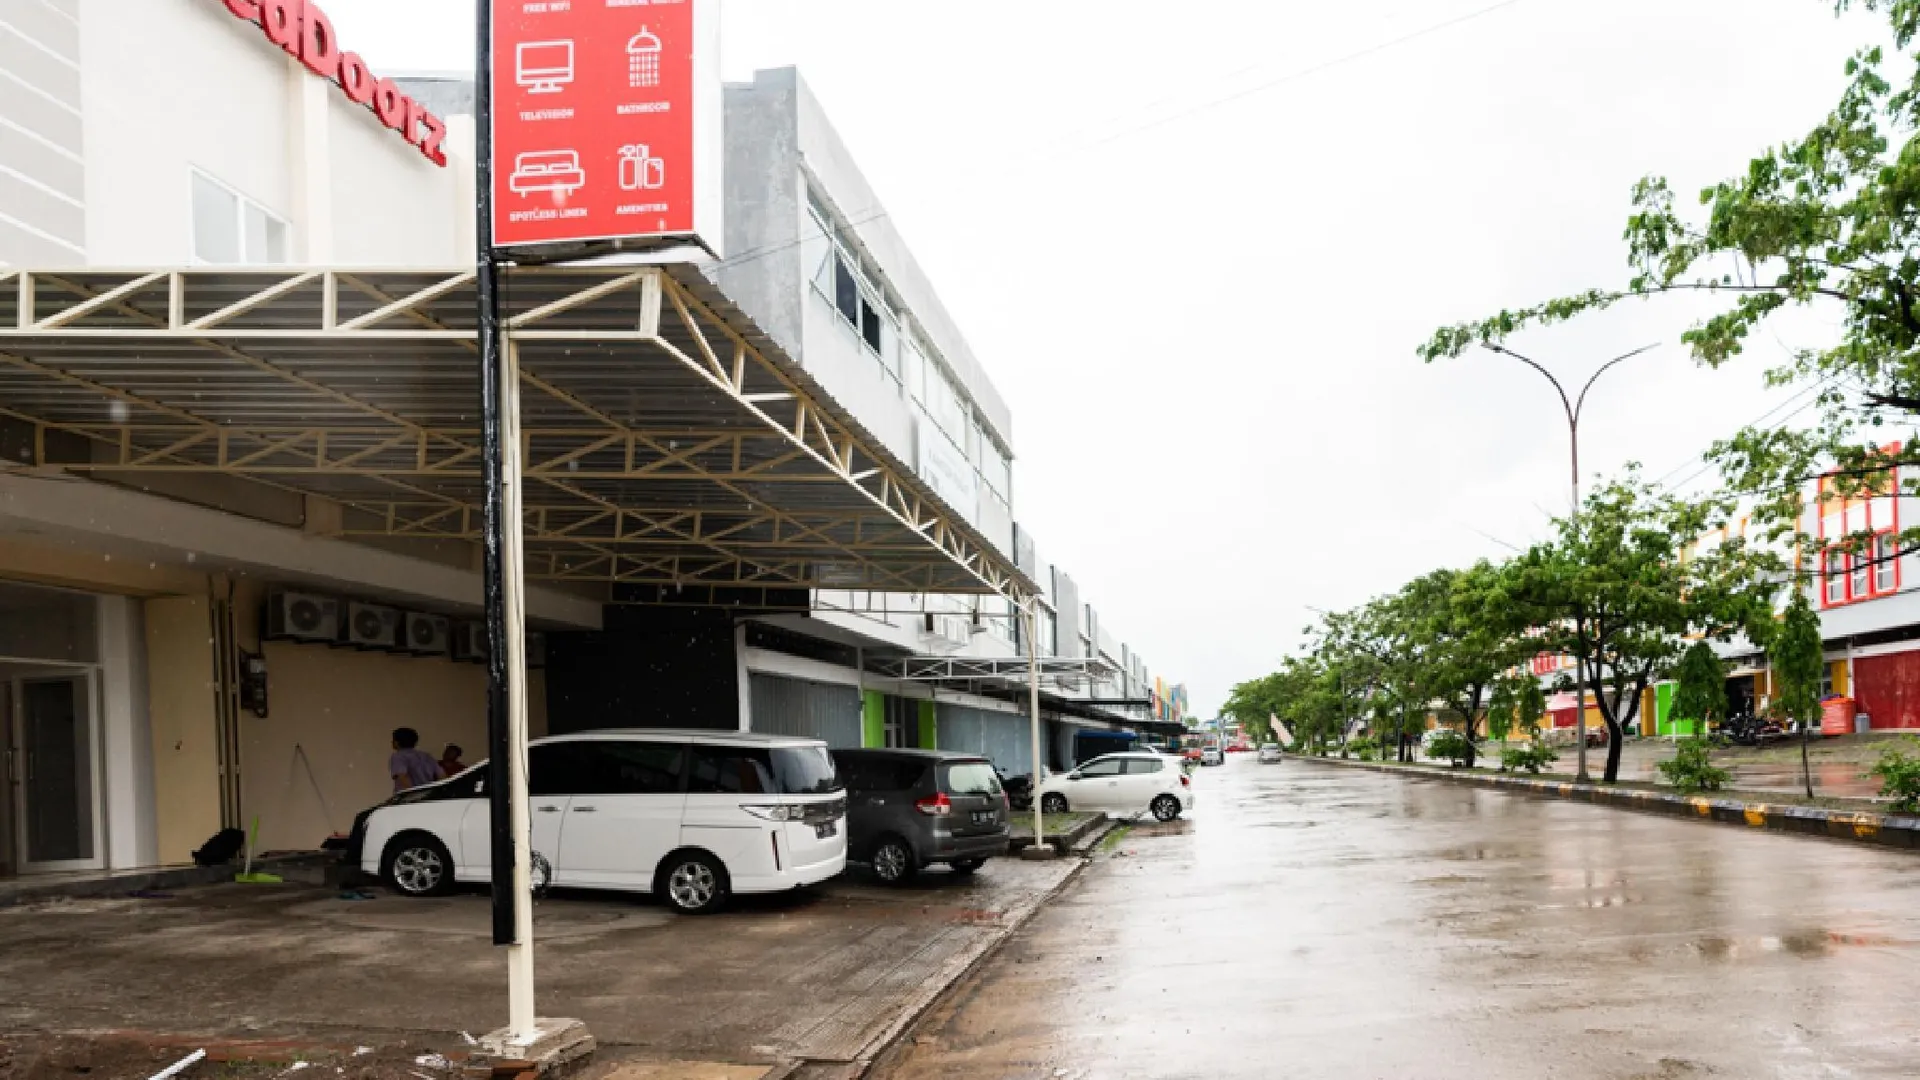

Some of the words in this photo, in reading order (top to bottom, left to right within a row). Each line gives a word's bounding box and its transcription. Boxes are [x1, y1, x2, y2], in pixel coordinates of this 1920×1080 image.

[519, 108, 575, 121] TELEVISION
[616, 101, 671, 115] BATHROOM
[509, 208, 557, 222] SPOTLESS
[616, 203, 669, 215] AMENITIES
